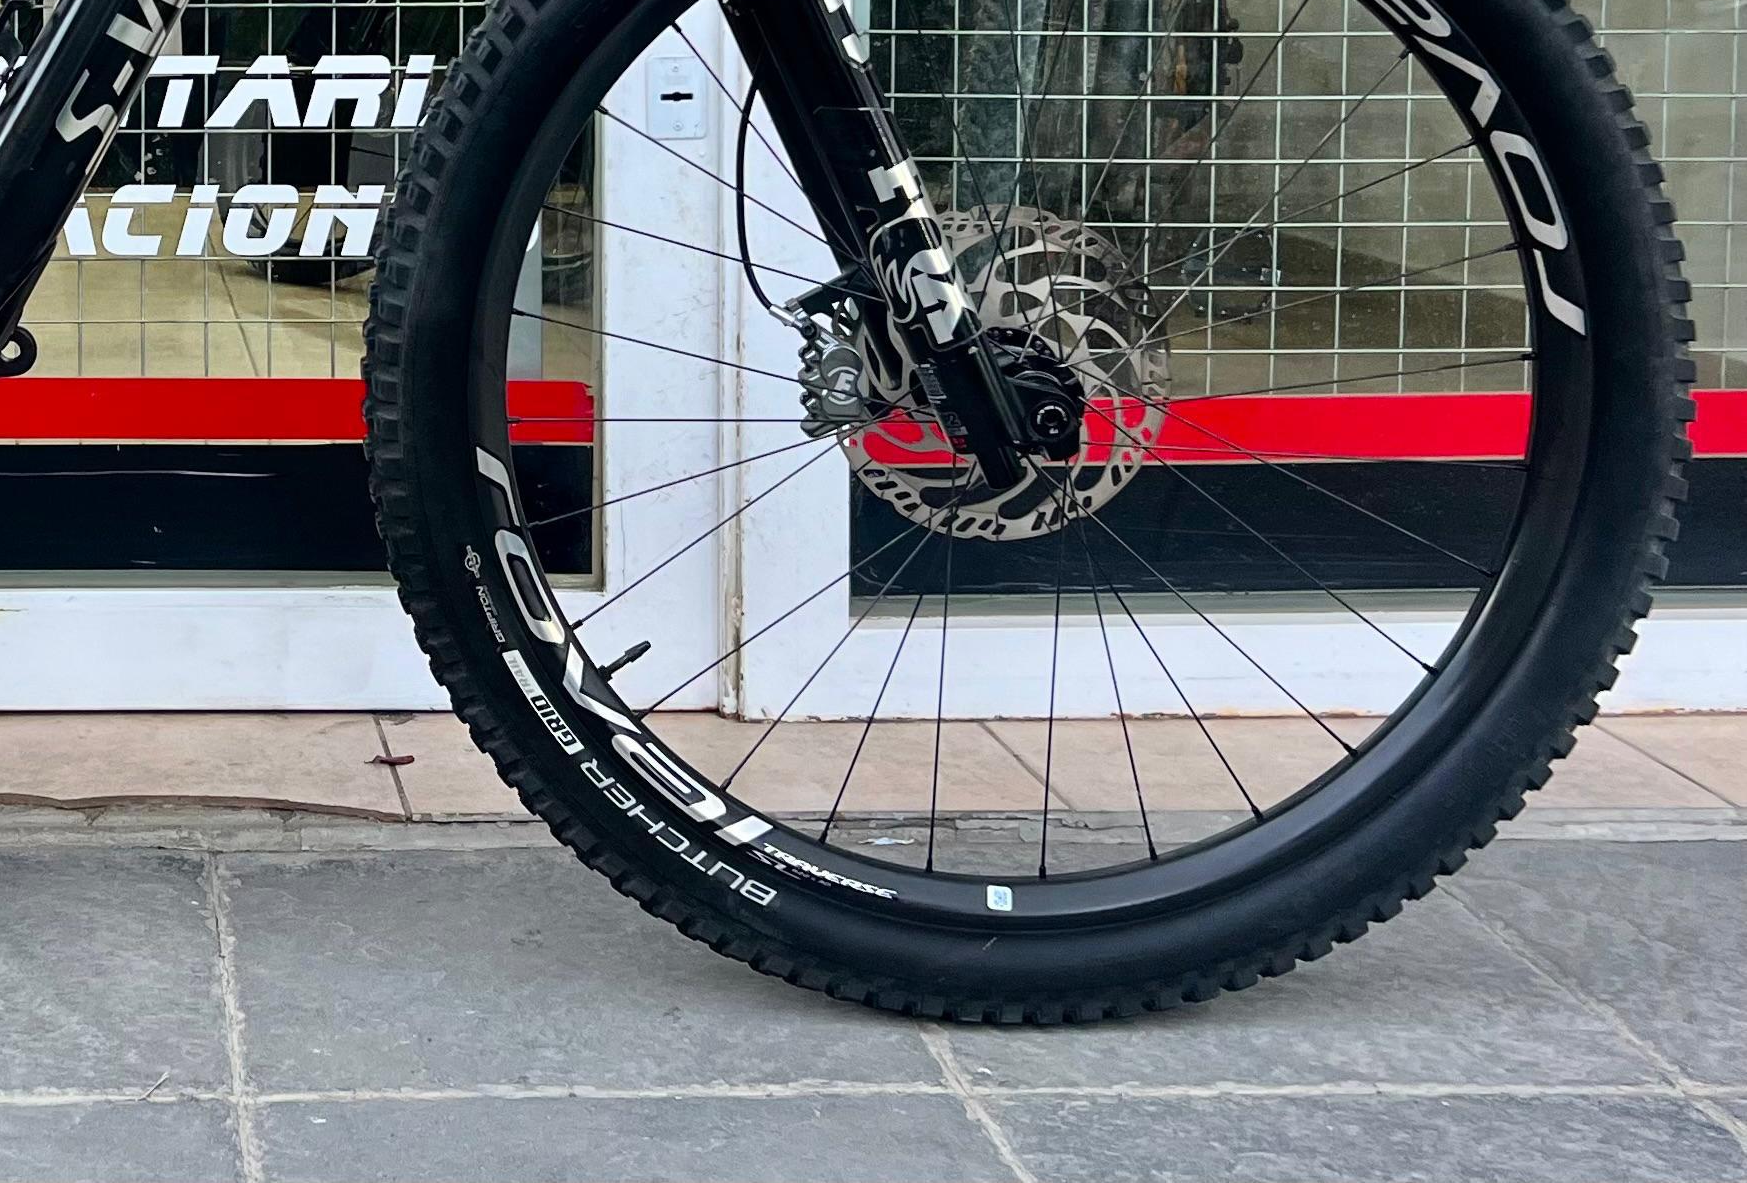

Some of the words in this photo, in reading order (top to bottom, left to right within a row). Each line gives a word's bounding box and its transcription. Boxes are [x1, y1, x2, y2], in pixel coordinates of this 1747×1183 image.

[476, 585, 505, 643] GRIPTON
[476, 447, 773, 846] ROVAL
[505, 655, 540, 696] TRAIL
[530, 694, 578, 747] GRID
[580, 758, 778, 907] BUTCHER
[763, 842, 898, 900] TRAVERSE
